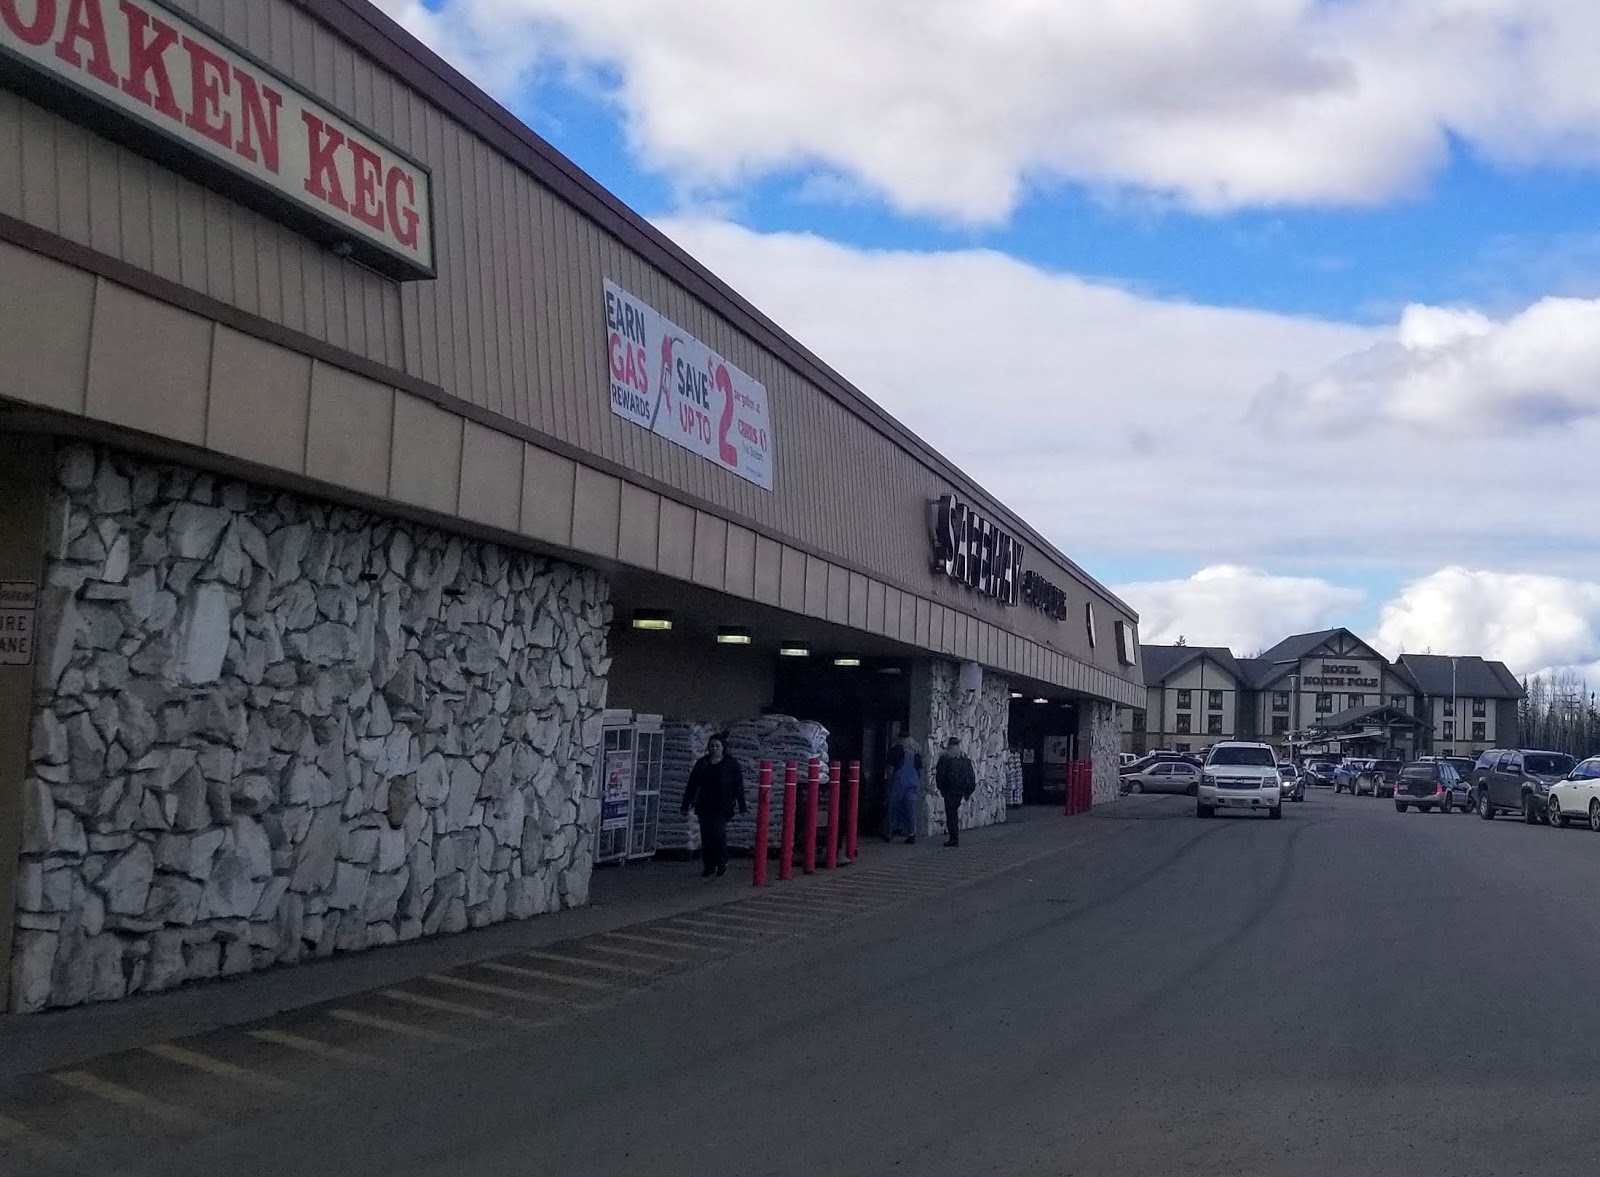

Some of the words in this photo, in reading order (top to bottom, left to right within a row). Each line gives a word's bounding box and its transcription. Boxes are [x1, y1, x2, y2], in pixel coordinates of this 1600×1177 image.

[302, 108, 419, 250] KEG
[606, 291, 646, 348] EARN
[609, 332, 648, 395] GAS
[676, 357, 710, 410] SAVE
[612, 383, 650, 420] REWARDS
[679, 401, 694, 435] UP
[696, 411, 711, 445] TO
[1303, 676, 1345, 687] NORTH
[1347, 677, 1378, 688] POLE
[1322, 664, 1360, 674] HOTEL
